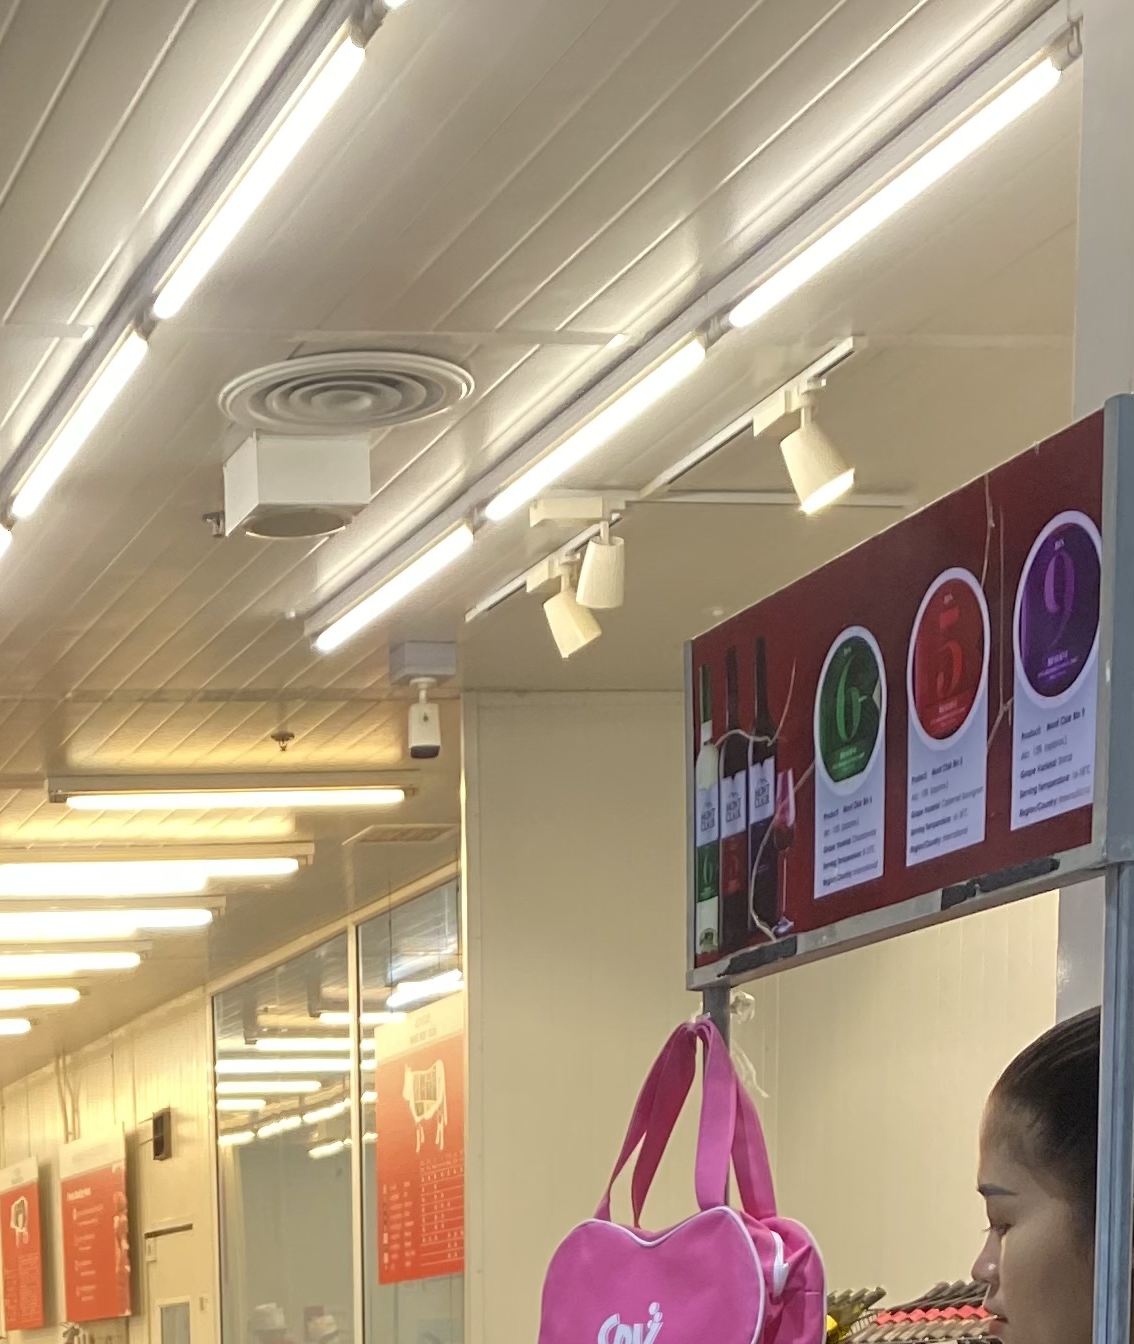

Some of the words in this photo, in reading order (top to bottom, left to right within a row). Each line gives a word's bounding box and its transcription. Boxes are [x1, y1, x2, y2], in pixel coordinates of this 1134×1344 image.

[1044, 551, 1075, 650] 9
[836, 655, 862, 741] 6
[937, 606, 963, 699] 5
